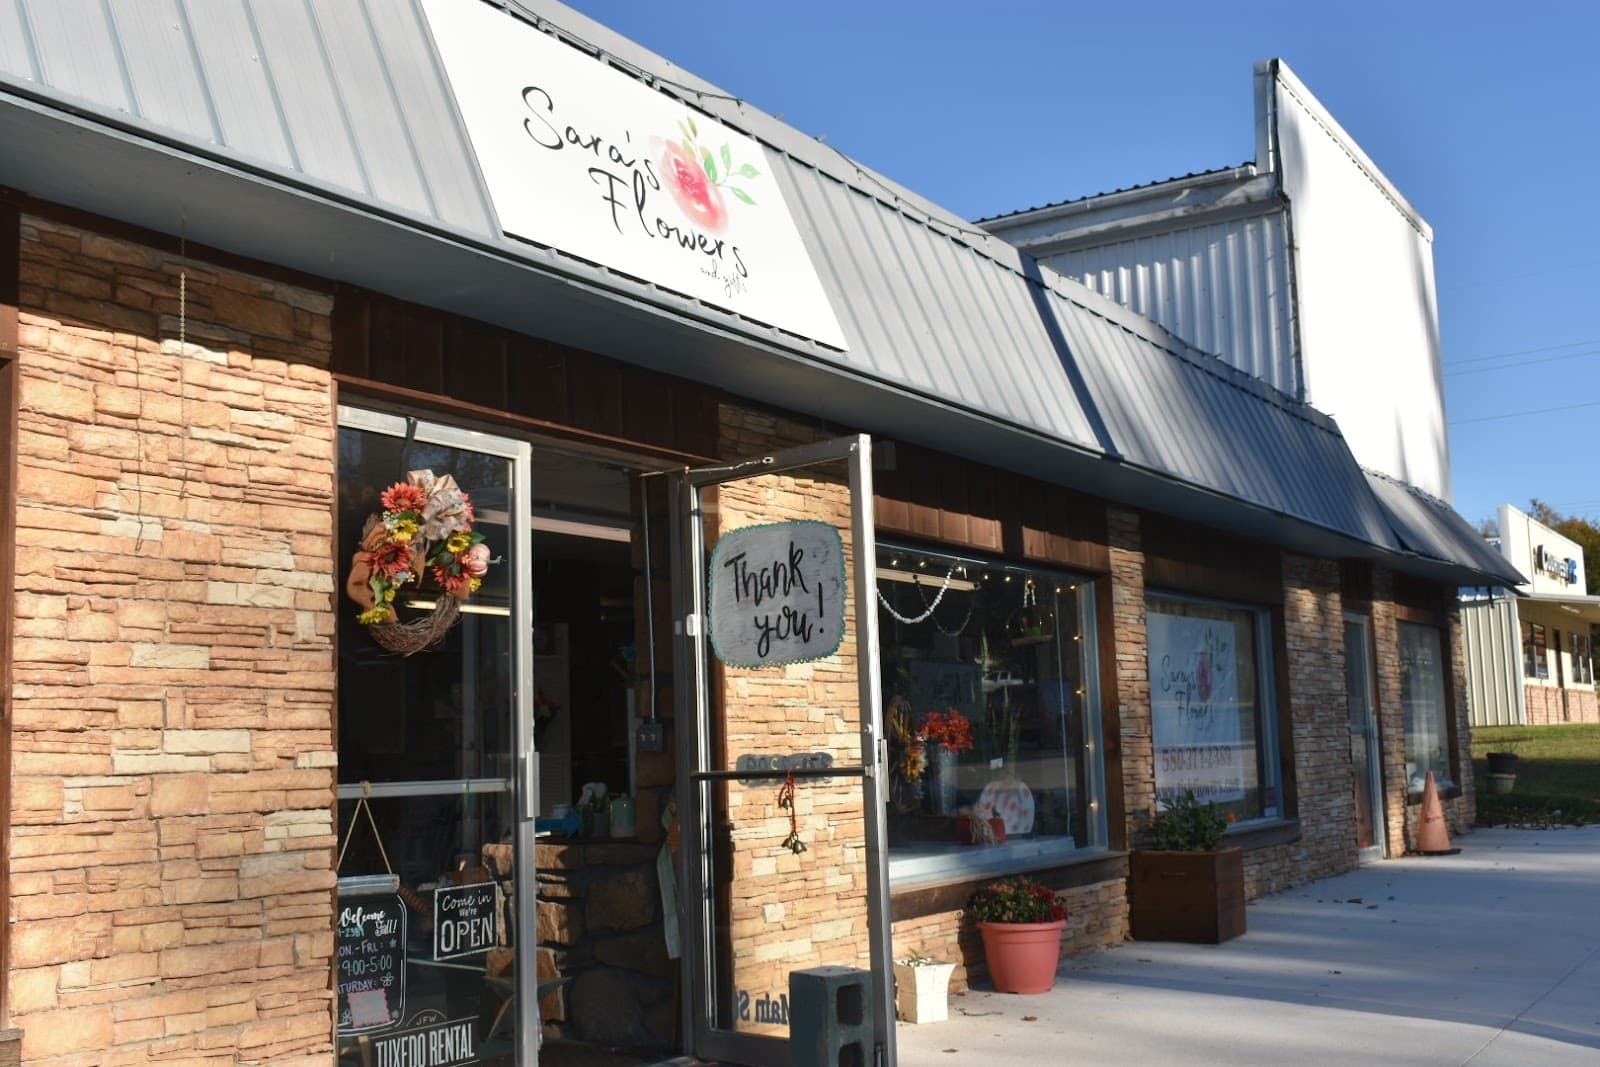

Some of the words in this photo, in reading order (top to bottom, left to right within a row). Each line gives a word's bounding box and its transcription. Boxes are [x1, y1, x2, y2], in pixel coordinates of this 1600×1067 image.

[521, 86, 660, 191] Sara's
[588, 167, 748, 278] Flowers
[724, 541, 809, 607] Thank
[754, 582, 825, 658] you!
[442, 895, 475, 911] Come
[477, 889, 492, 905] in
[459, 906, 478, 917] We're
[440, 912, 494, 953] OPEN
[416, 1014, 438, 1026] JFW
[375, 1032, 427, 1067] TUXEDO
[429, 1023, 475, 1067] RENTAL
